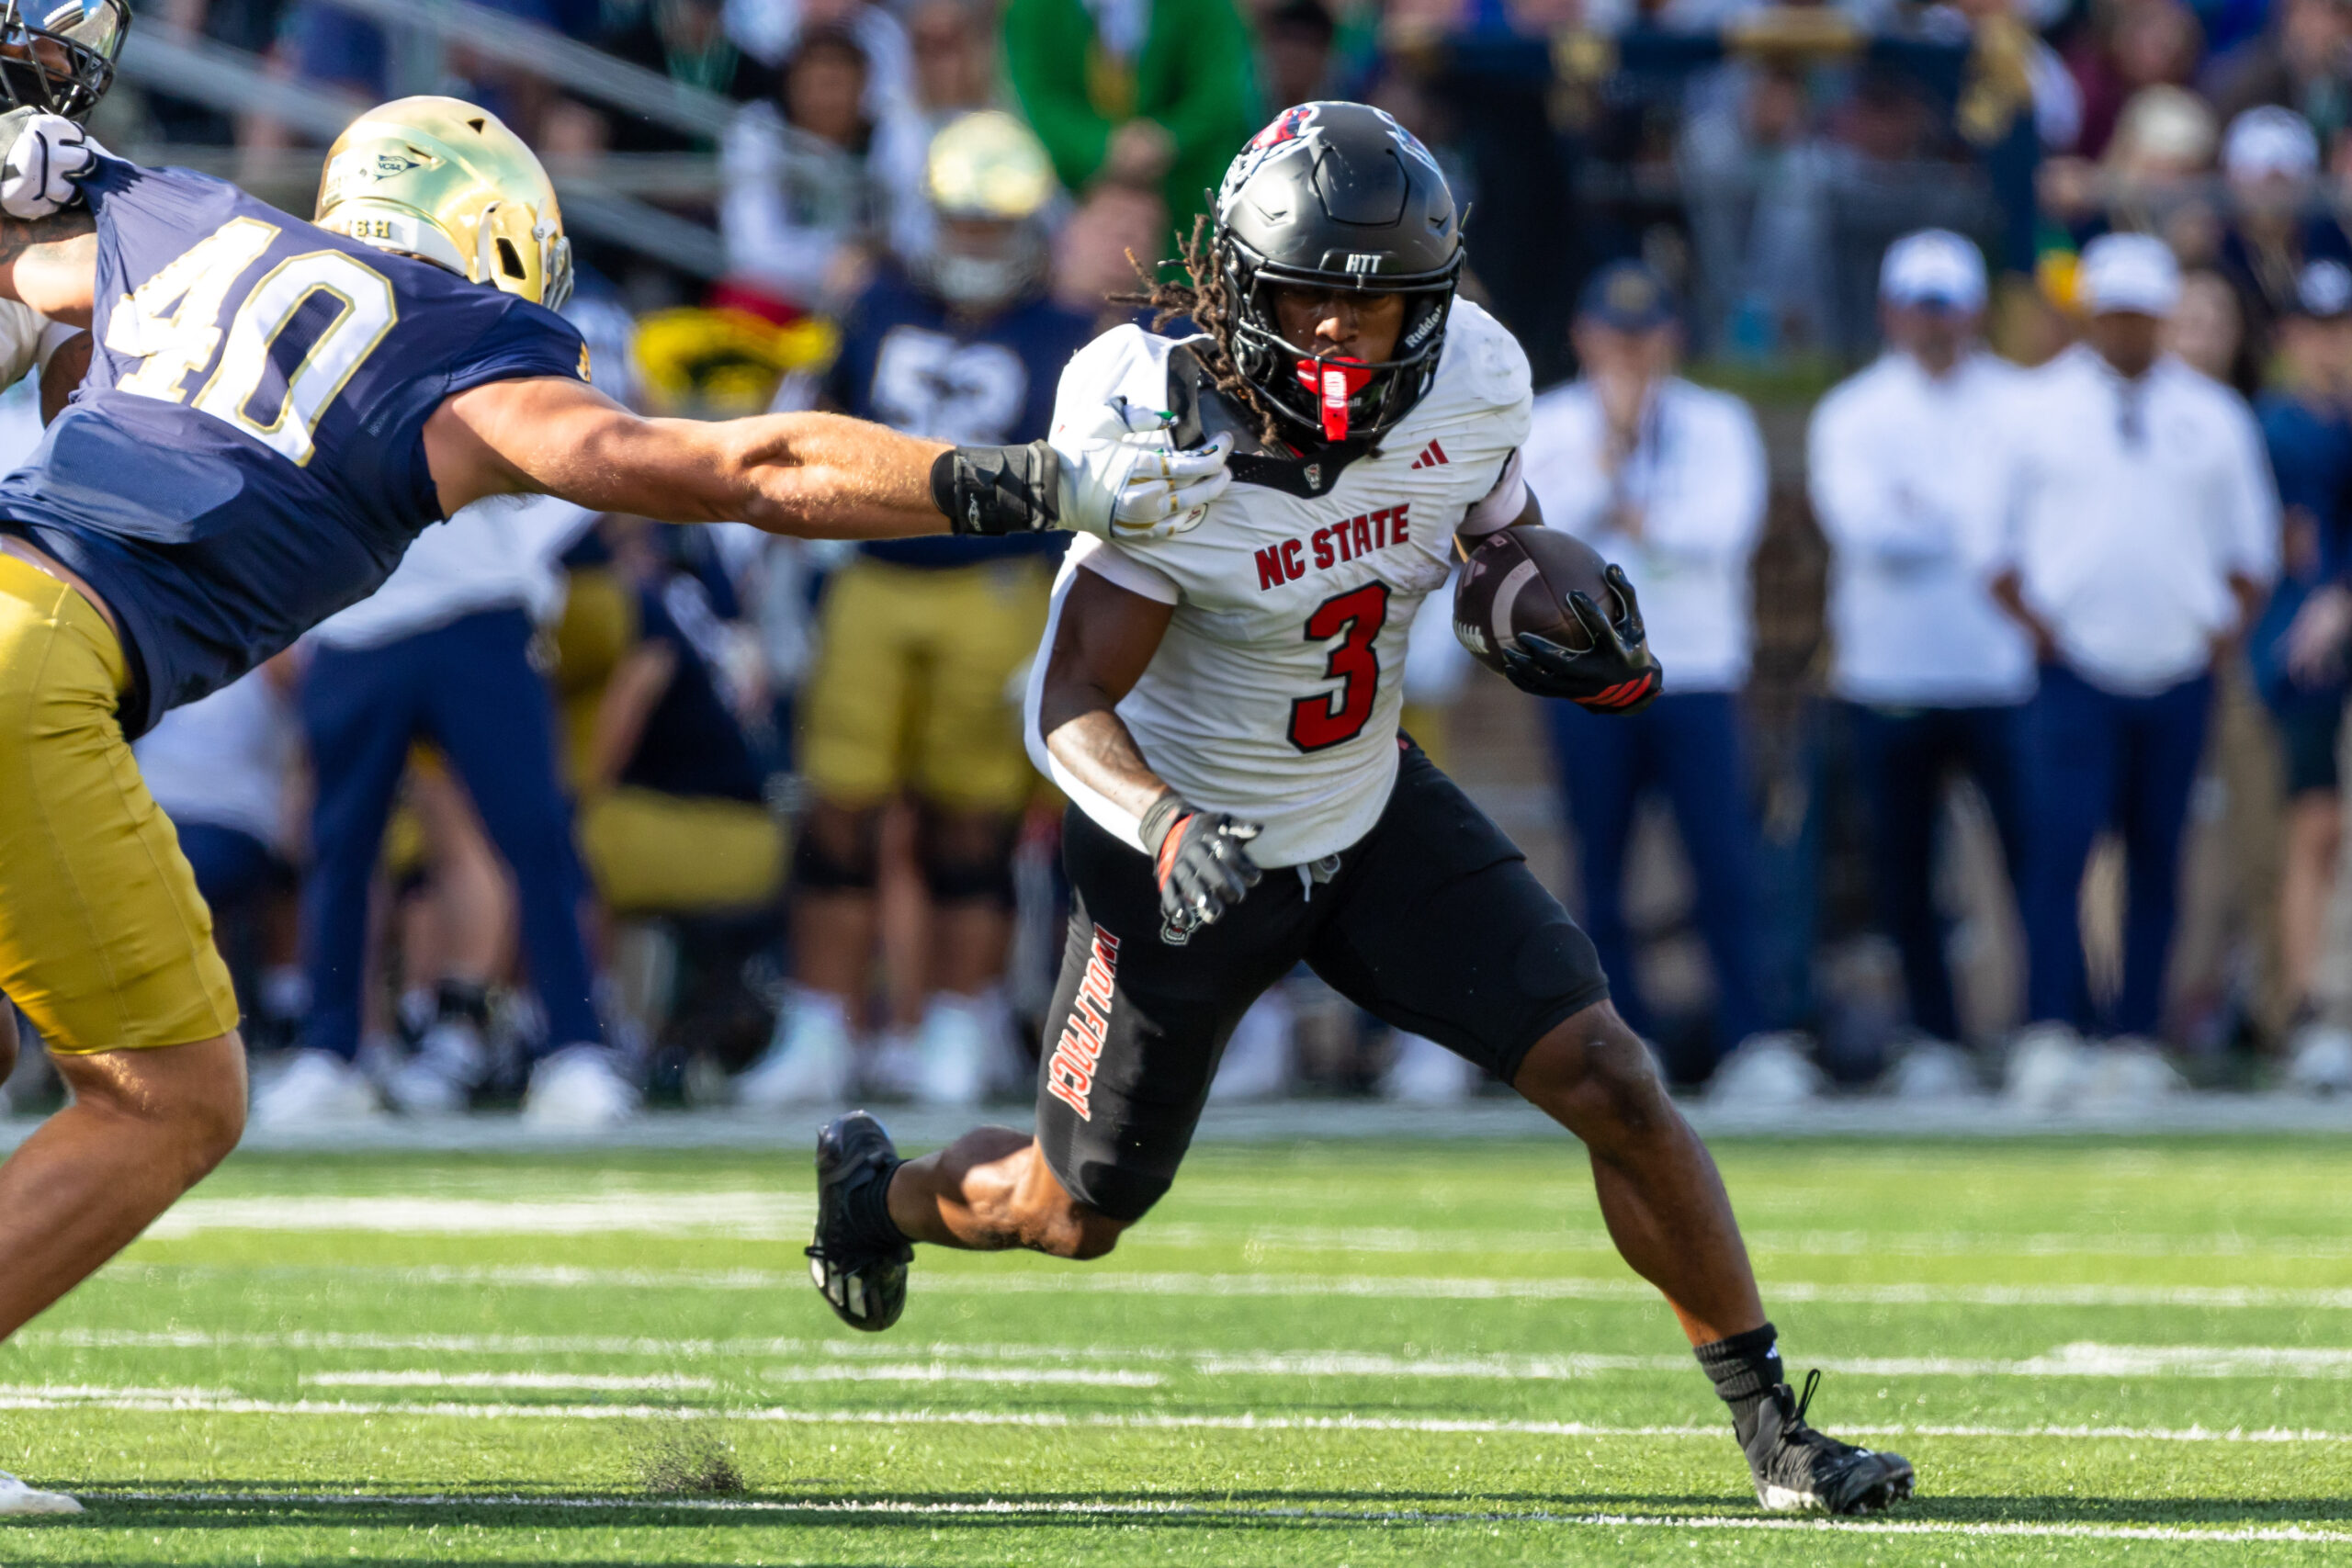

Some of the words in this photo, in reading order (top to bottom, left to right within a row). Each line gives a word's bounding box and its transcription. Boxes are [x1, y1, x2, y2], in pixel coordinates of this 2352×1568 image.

[1345, 254, 1382, 274] HTT
[1405, 304, 1443, 348] Ridde
[105, 215, 398, 468] 40
[1254, 537, 1306, 592] NC
[1311, 502, 1410, 570] STATE
[1286, 579, 1392, 754] 3
[1046, 921, 1120, 1122] WOLFPACK
